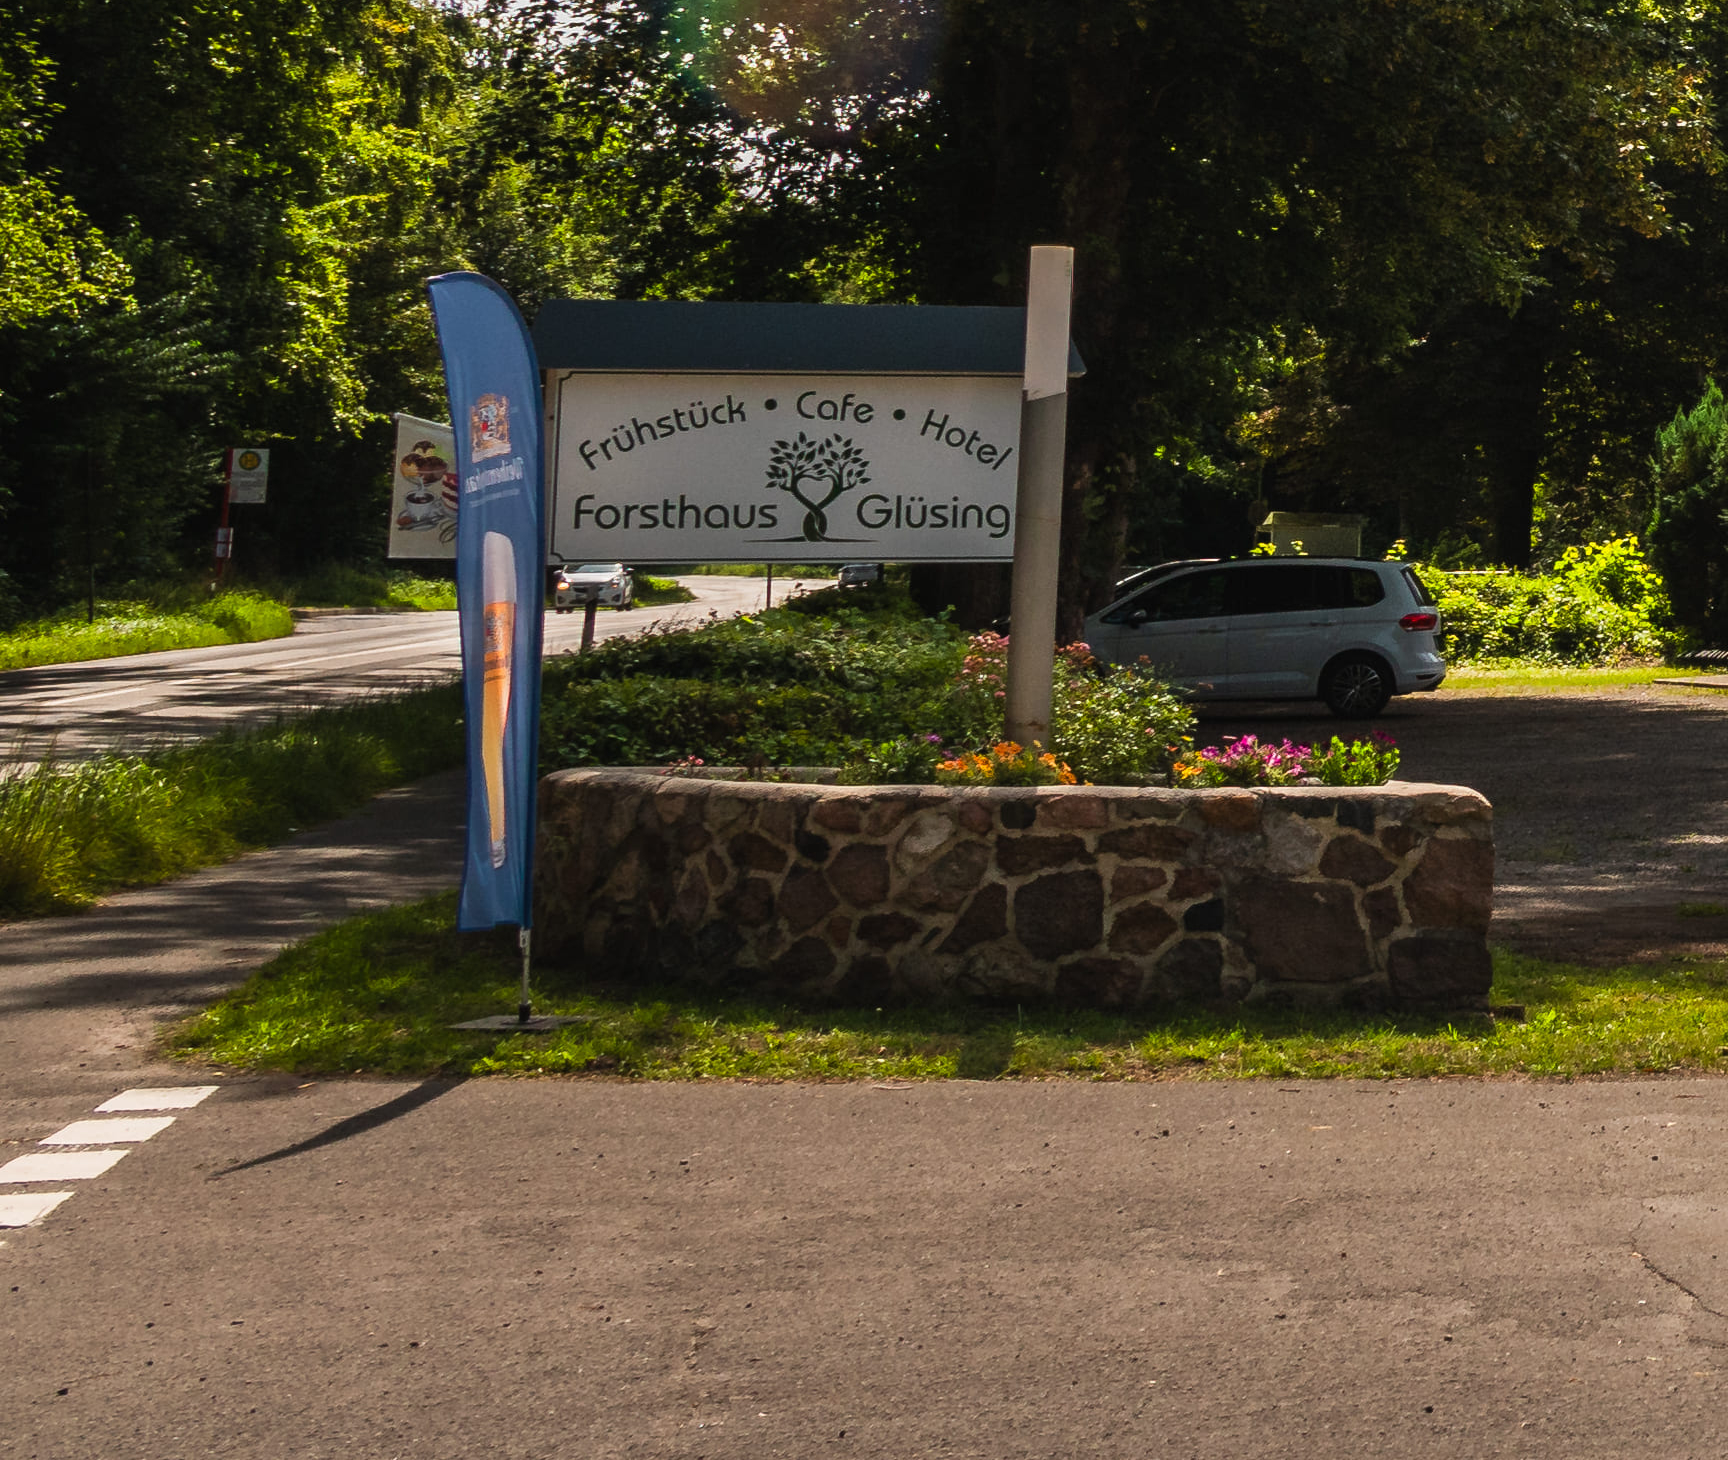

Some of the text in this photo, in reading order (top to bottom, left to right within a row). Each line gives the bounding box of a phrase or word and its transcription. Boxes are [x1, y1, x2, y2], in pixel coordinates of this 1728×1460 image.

[579, 391, 1013, 471] Frühstück Cafe Hotel
[573, 493, 1011, 538] Forsthaus Glüsing
